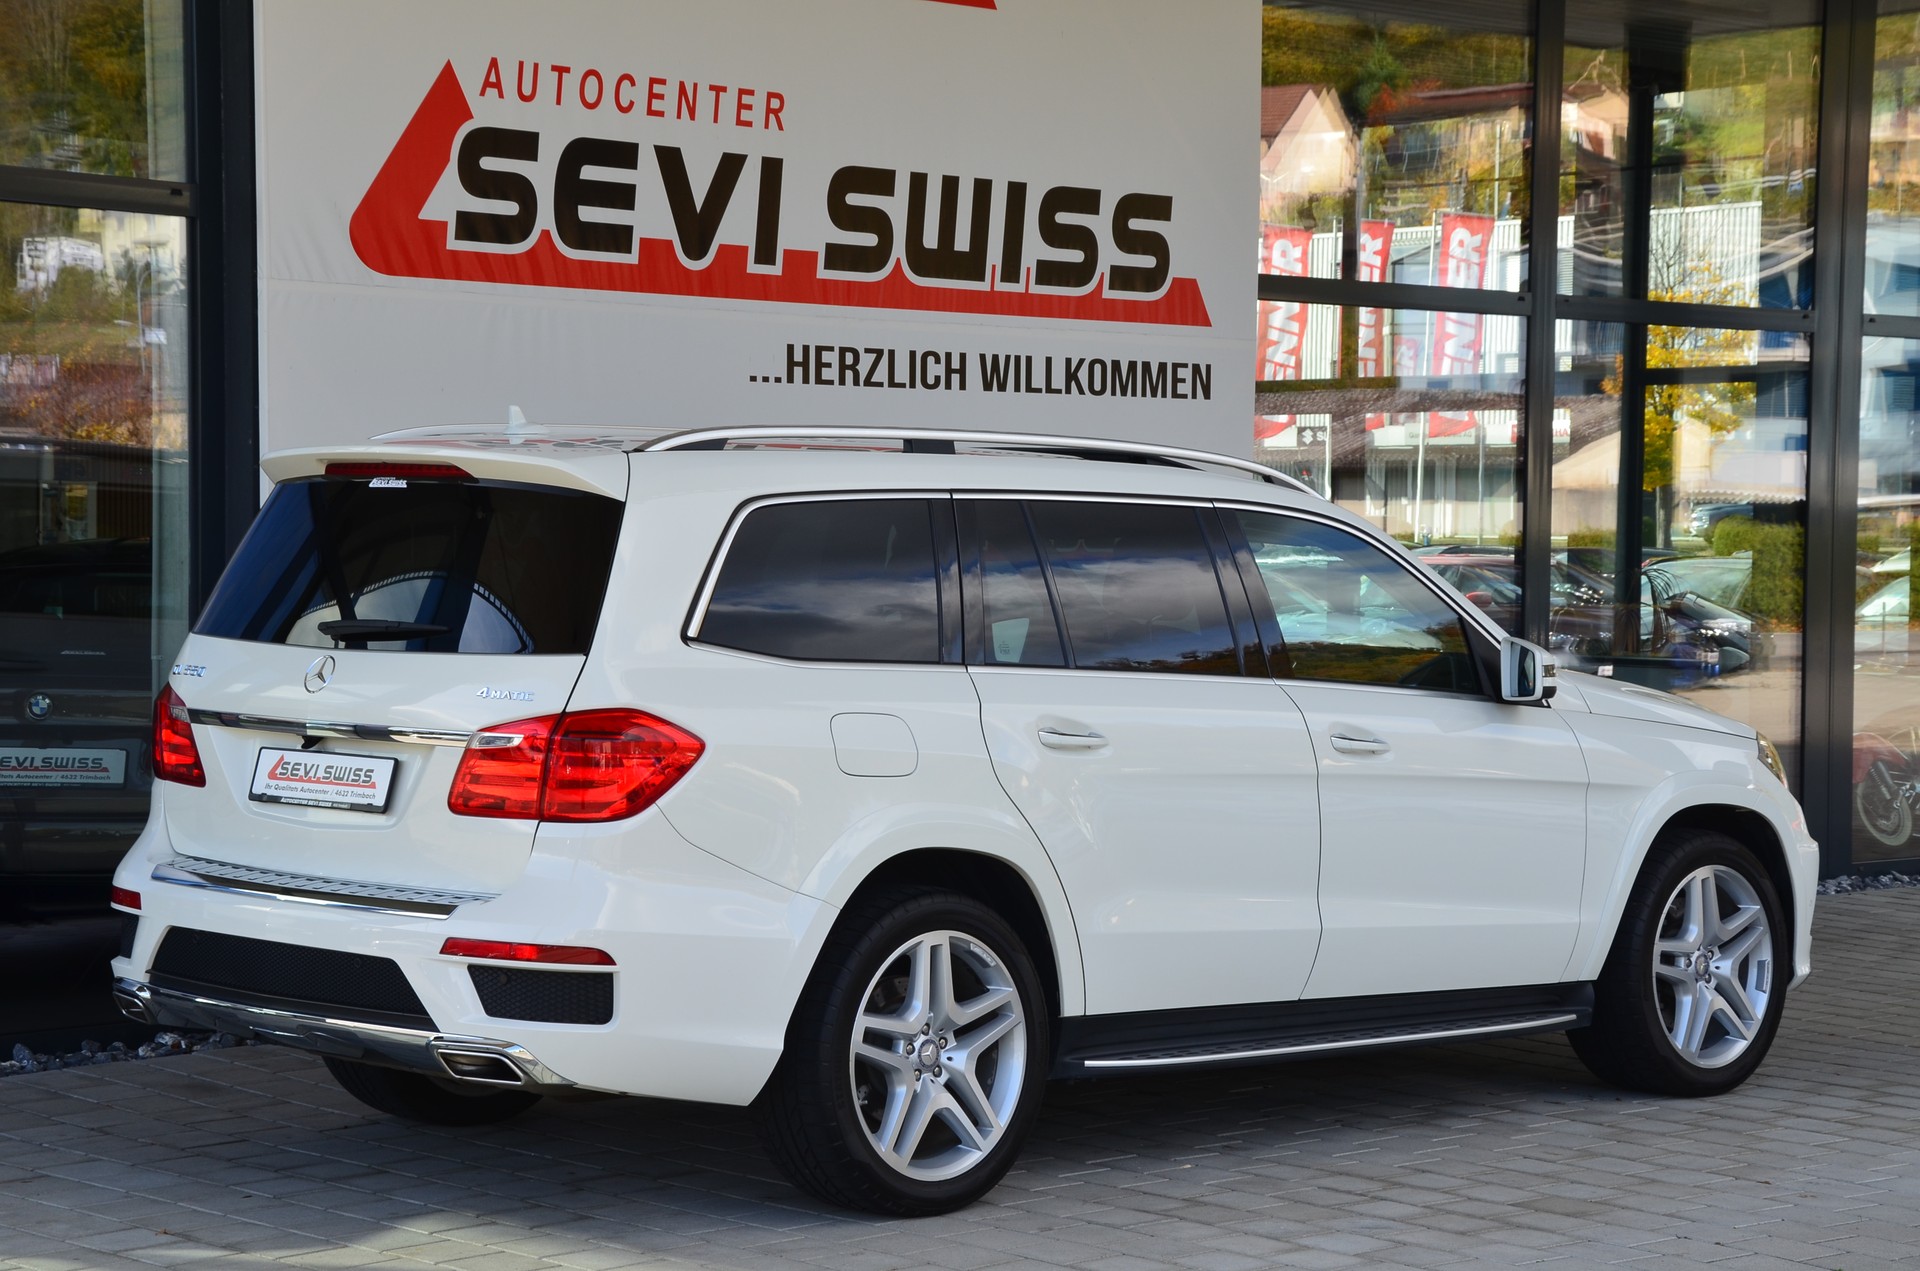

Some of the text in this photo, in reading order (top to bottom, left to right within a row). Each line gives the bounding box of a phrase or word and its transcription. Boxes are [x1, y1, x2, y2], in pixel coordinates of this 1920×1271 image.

[479, 56, 785, 131] AUTOCENTER
[453, 126, 1173, 293] SEVI SWISS
[978, 353, 1212, 401] WILLKOMMEN
[0, 756, 104, 769] EVI SWISS
[278, 761, 375, 783] SEVI SWISS
[299, 786, 330, 795] Autocenter
[350, 790, 376, 799] Trimbach
